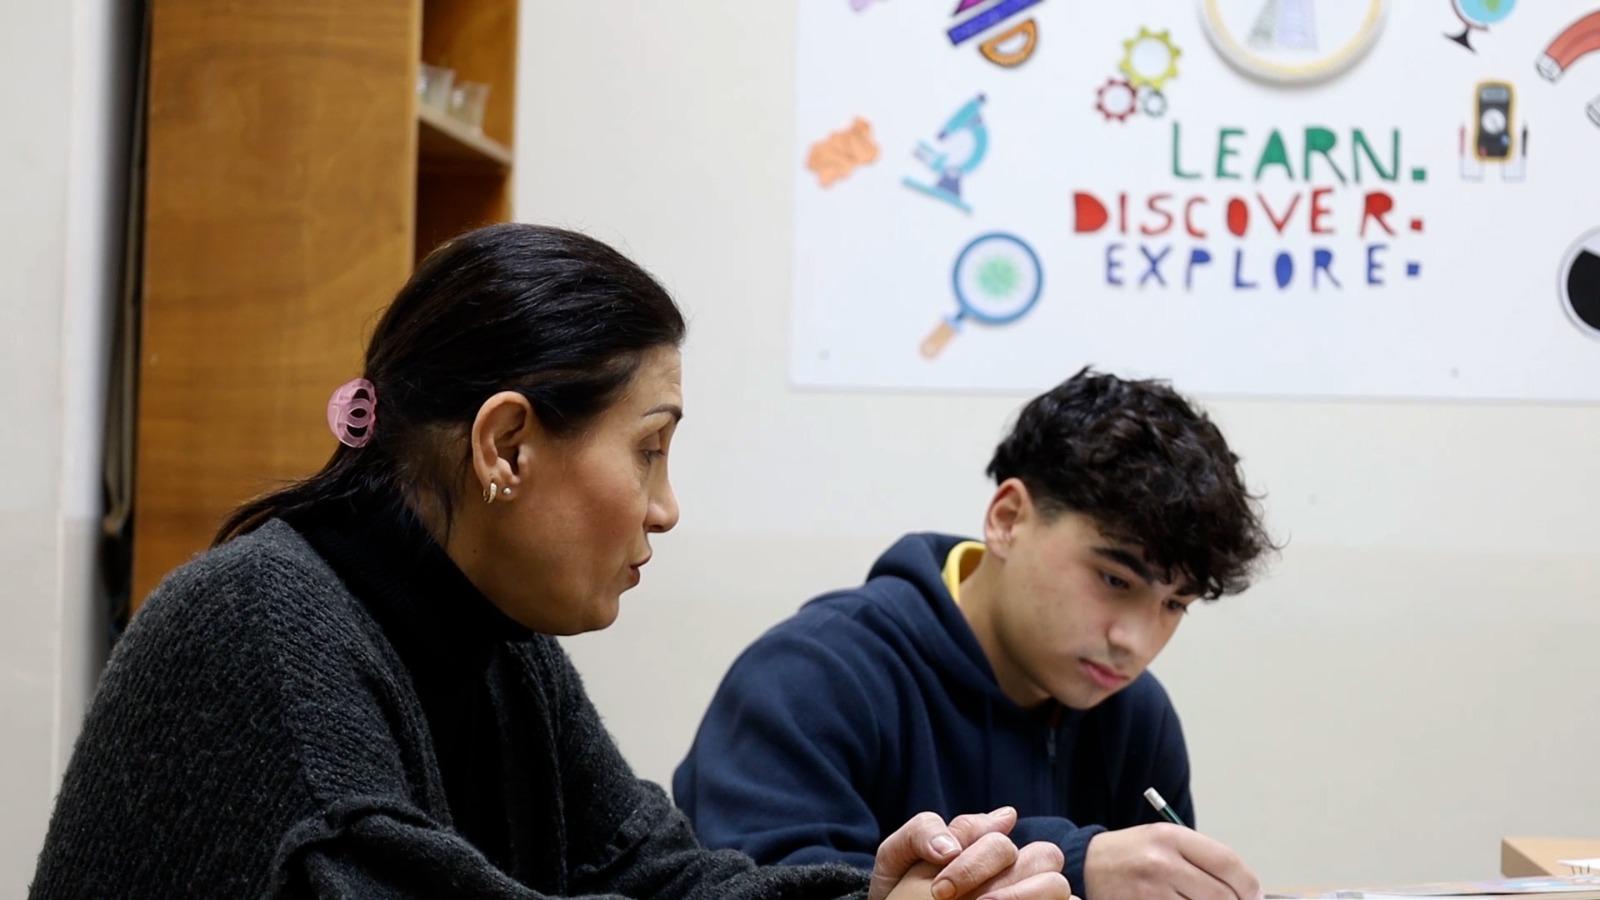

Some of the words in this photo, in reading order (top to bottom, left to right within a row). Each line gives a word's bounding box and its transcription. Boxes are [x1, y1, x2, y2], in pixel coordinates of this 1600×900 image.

[1171, 121, 1426, 184] LEARN.
[1073, 187, 1424, 239] DISCOVER.
[1105, 244, 1421, 290] EXPLORE.
